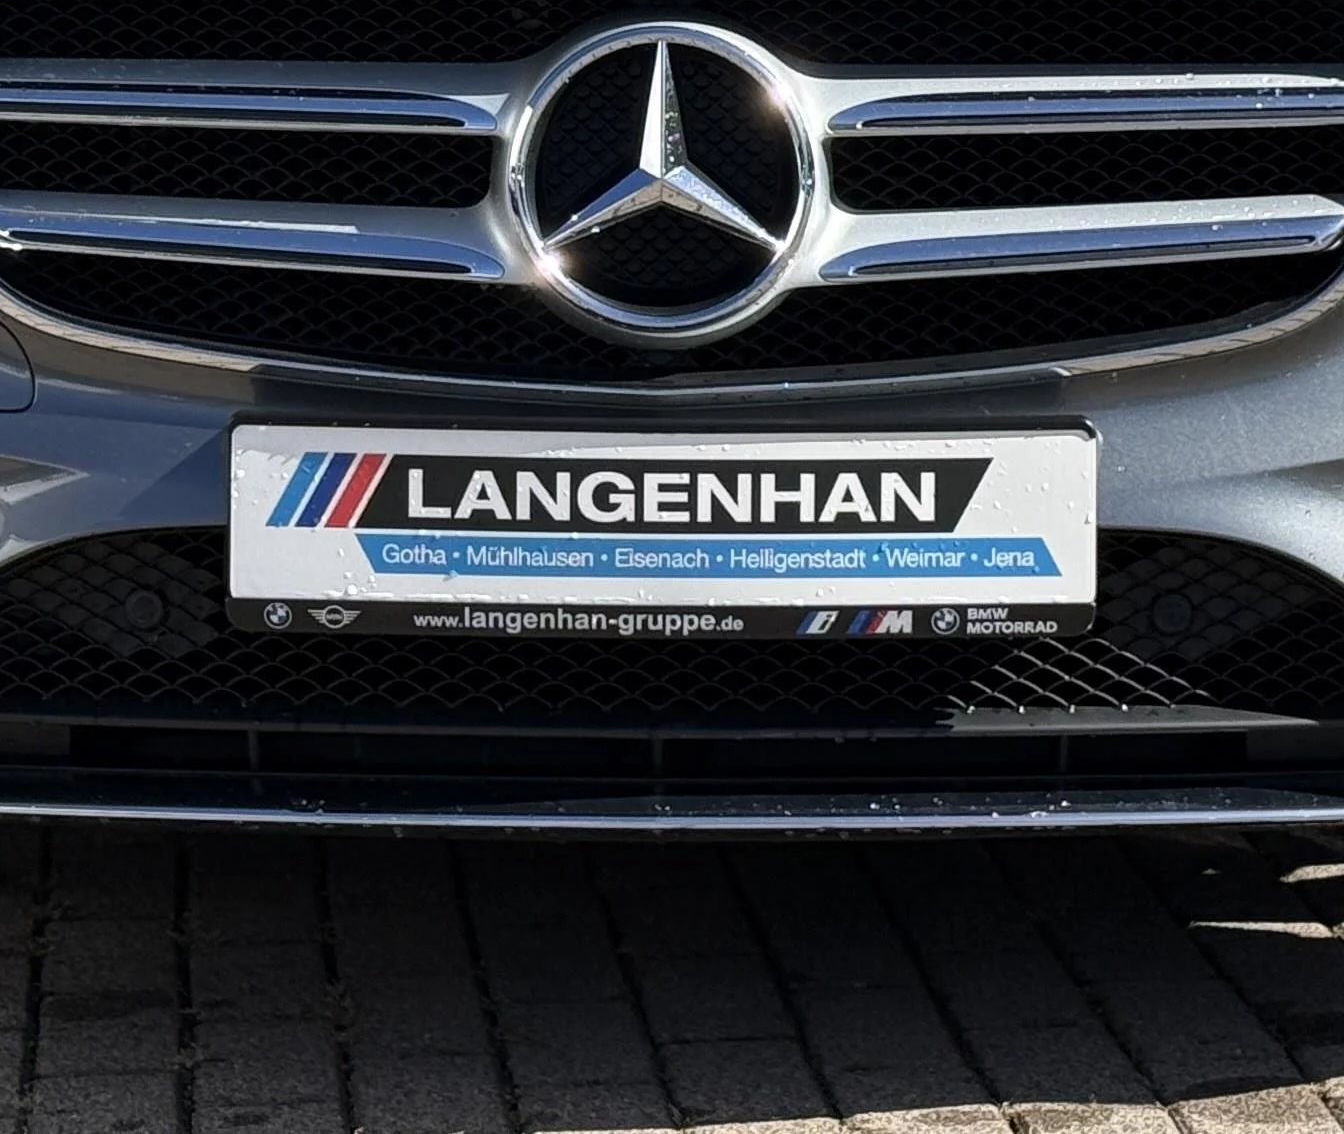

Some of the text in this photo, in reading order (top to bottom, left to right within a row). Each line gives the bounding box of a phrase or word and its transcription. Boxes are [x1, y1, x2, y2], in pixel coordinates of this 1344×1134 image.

[407, 468, 937, 524] LANGENHAN
[382, 543, 1035, 574] Gotha Mühlhausen Eisenach Heiligenstadt Weimar Jena
[413, 607, 745, 634] www.langenhan-gruppe.de
[966, 607, 1009, 621] BMW
[966, 620, 1058, 635] MOTORRAD
